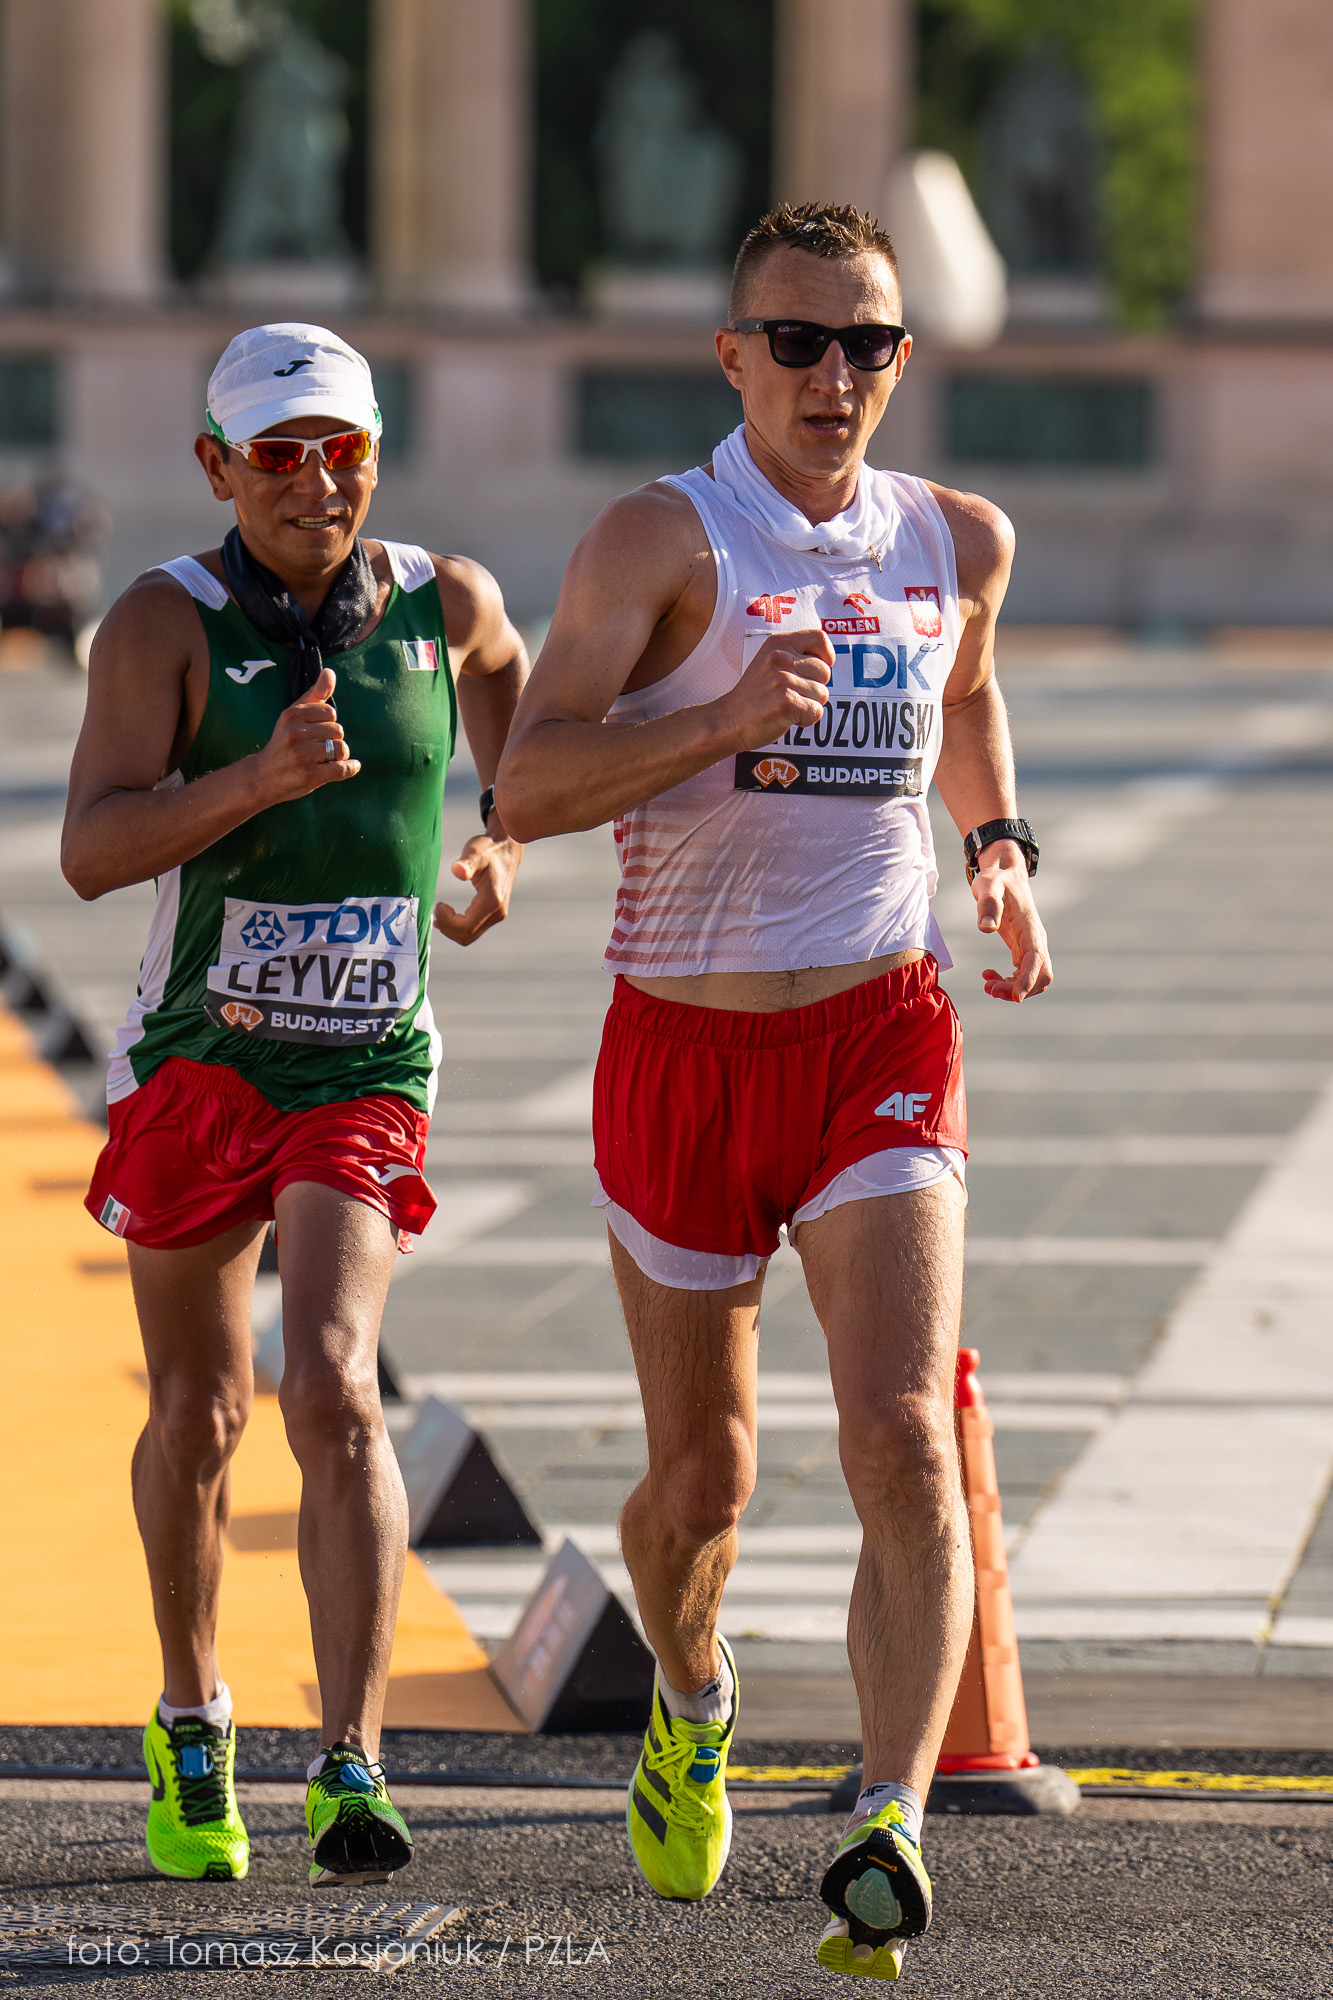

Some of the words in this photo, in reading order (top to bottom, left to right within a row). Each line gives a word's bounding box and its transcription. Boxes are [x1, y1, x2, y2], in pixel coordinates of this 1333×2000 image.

[746, 593, 797, 623] 4F
[824, 619, 877, 633] ORLEN
[773, 700, 934, 750] OZOWSKI
[287, 904, 407, 947] TDK
[227, 954, 399, 1003] LEYVER
[270, 1011, 382, 1035] BUDAPEST
[874, 1091, 932, 1121] 4F
